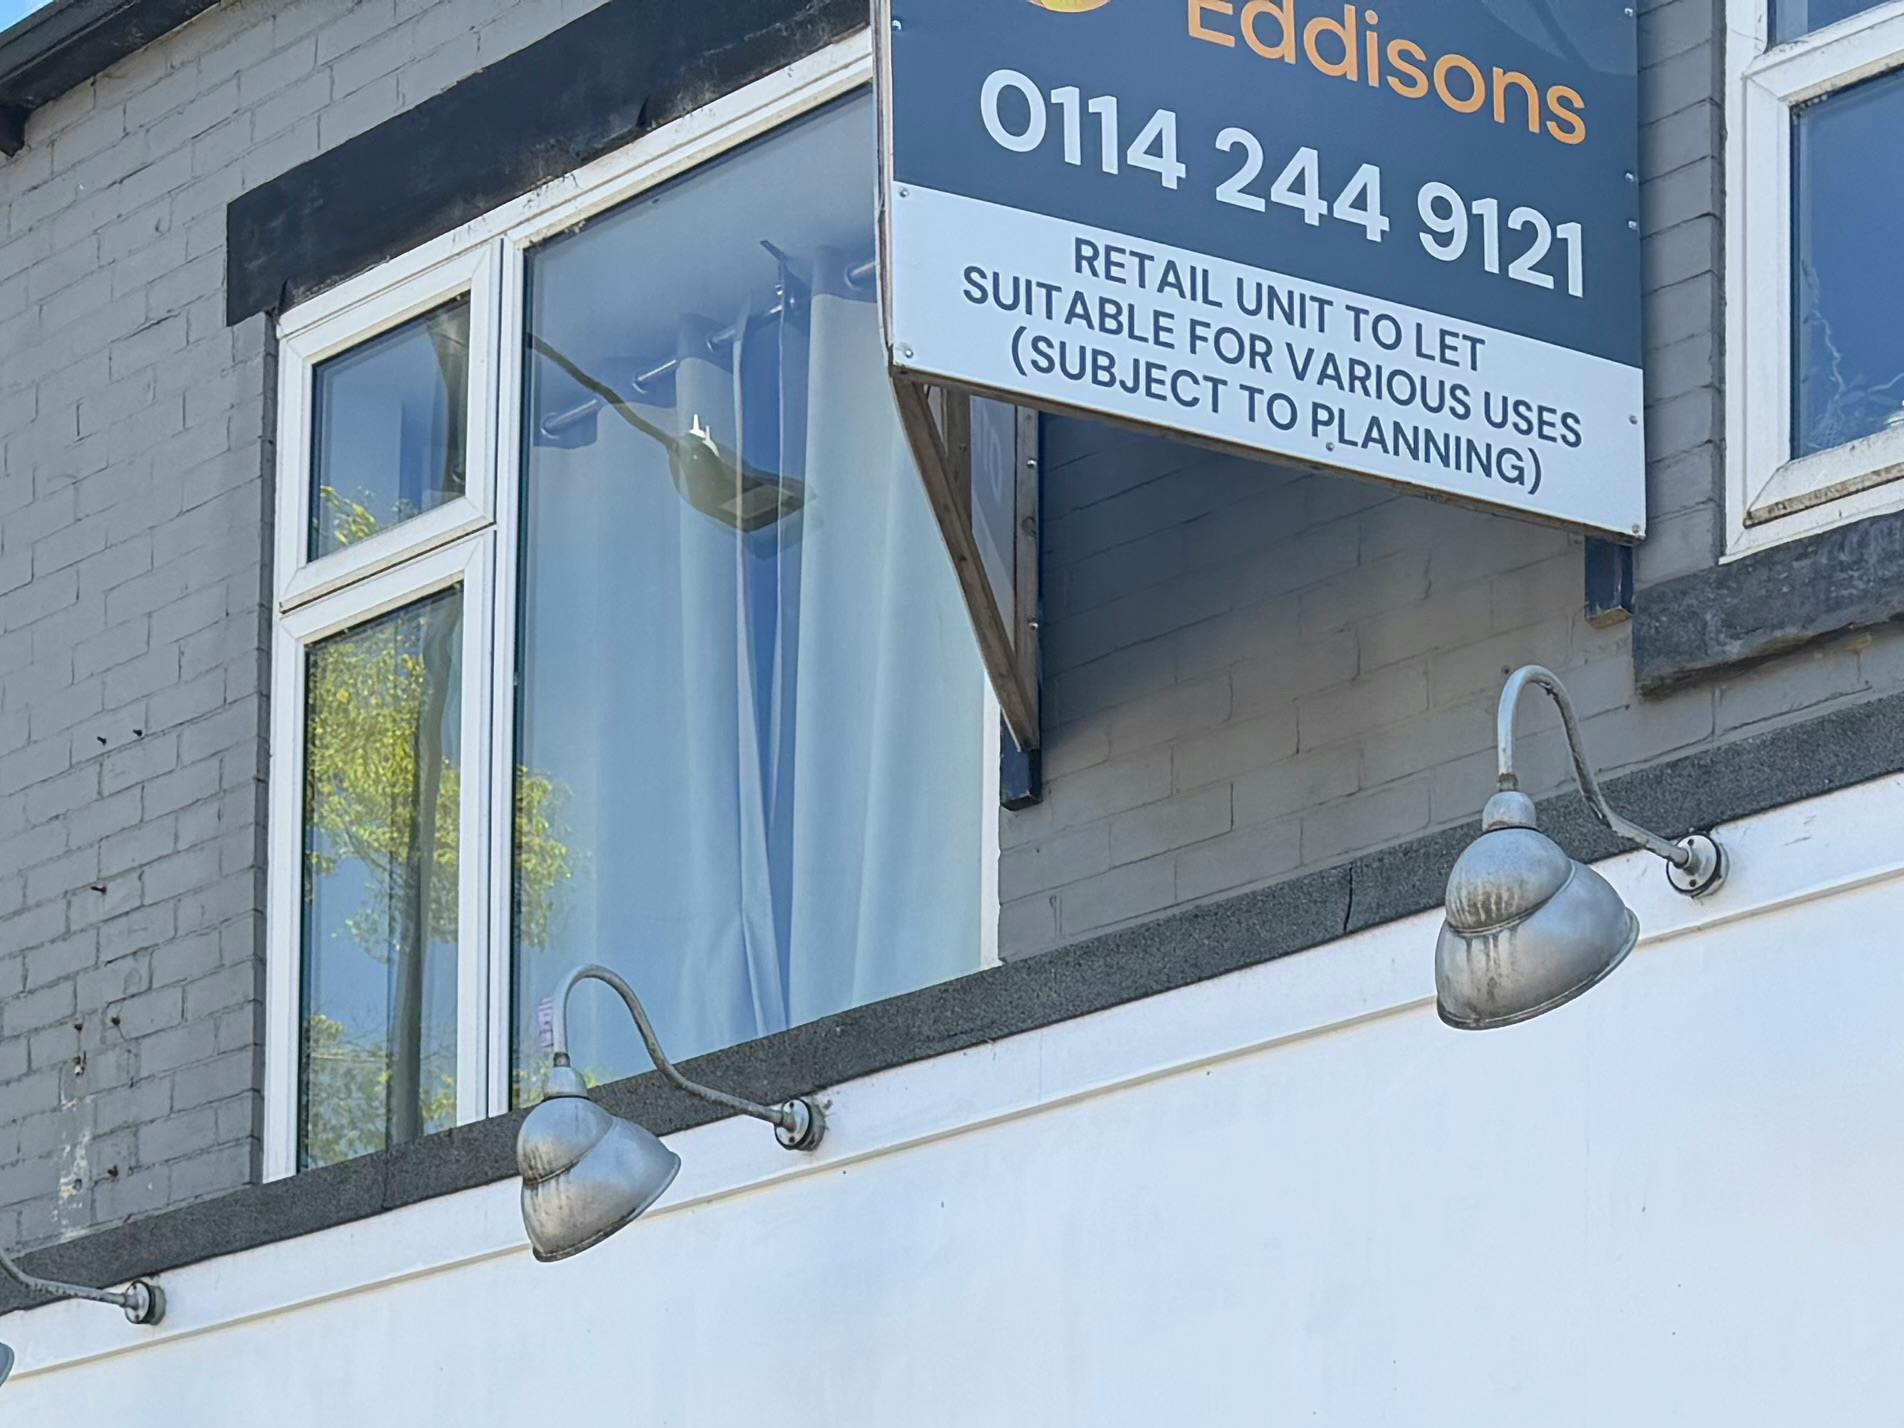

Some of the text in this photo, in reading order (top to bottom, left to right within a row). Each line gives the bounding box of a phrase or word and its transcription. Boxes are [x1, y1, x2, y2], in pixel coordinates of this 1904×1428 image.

[1188, 0, 1587, 146] Eddisons
[980, 68, 1584, 298] 0114 244 9121
[962, 265, 1584, 450] SUITABLE FOR VARIOUS USES
[1073, 236, 1486, 373] RETAIL UNIT TO LET
[1010, 325, 1544, 496] (SUBJECT TO PLANNING)
